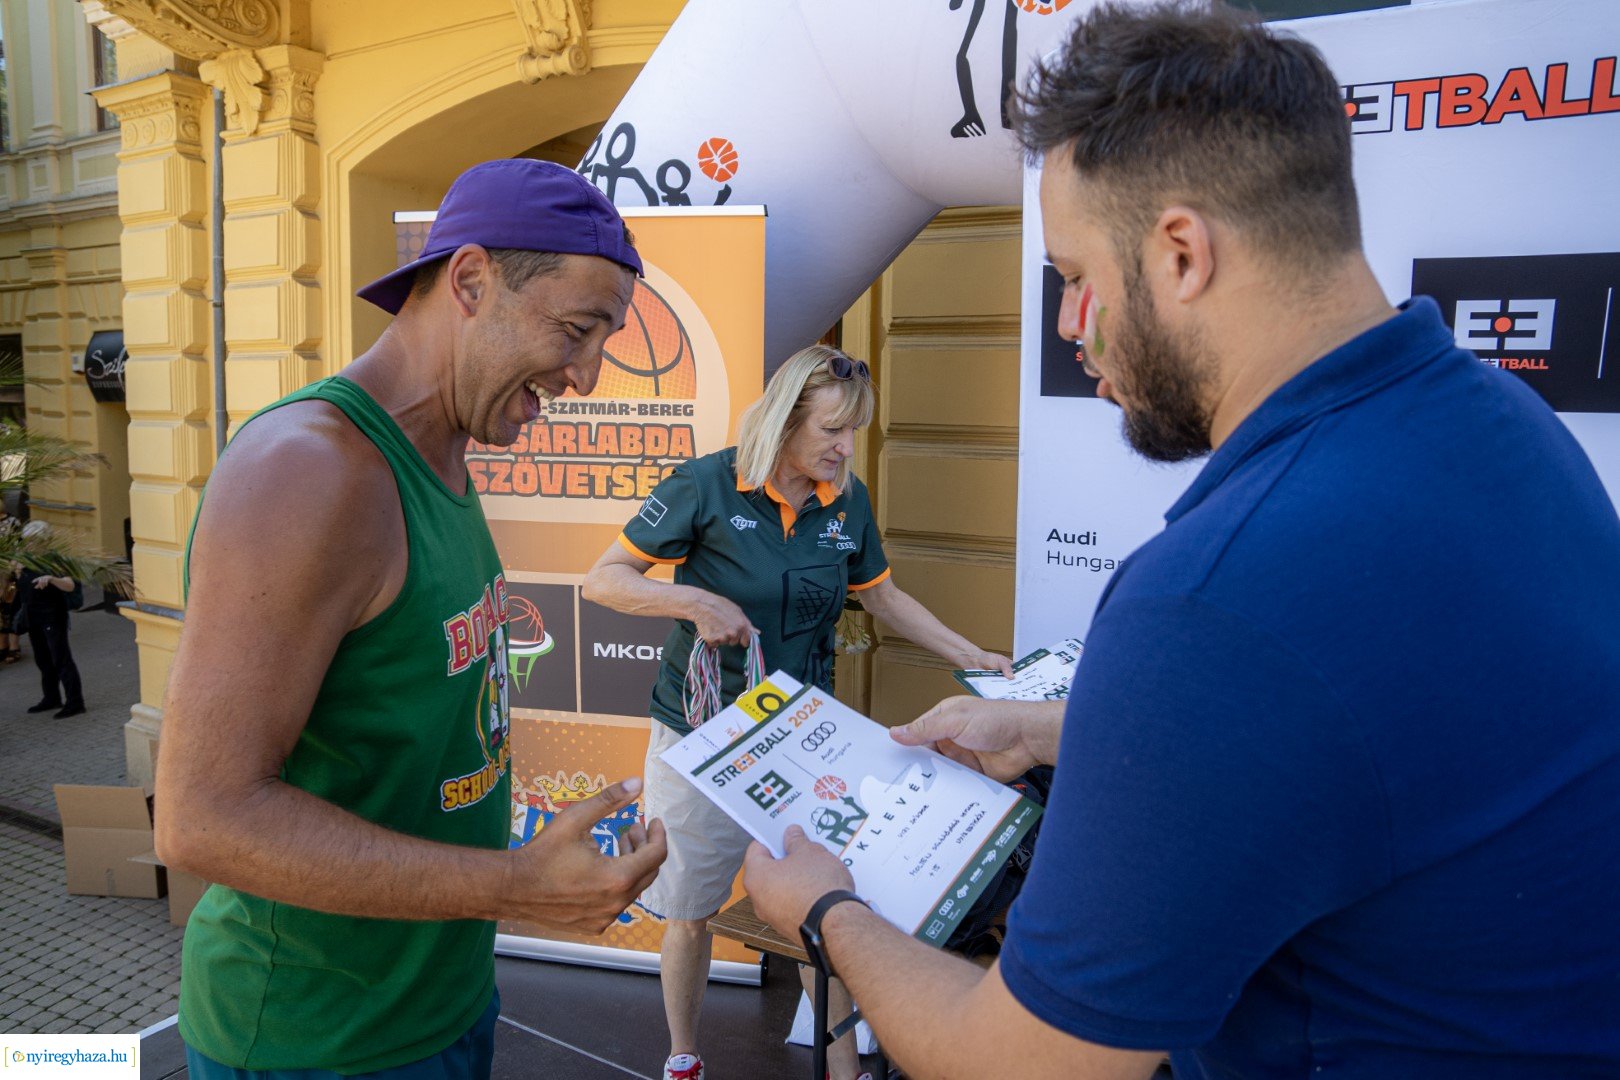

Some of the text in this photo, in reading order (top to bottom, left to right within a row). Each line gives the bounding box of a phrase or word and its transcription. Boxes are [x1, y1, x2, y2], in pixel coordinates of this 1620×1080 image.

[1341, 57, 1620, 134] ETBALL
[464, 415, 697, 458] SÁRLABDA
[1046, 528, 1097, 546] Audi
[1047, 550, 1125, 572] Hungar
[788, 697, 824, 728] 2024
